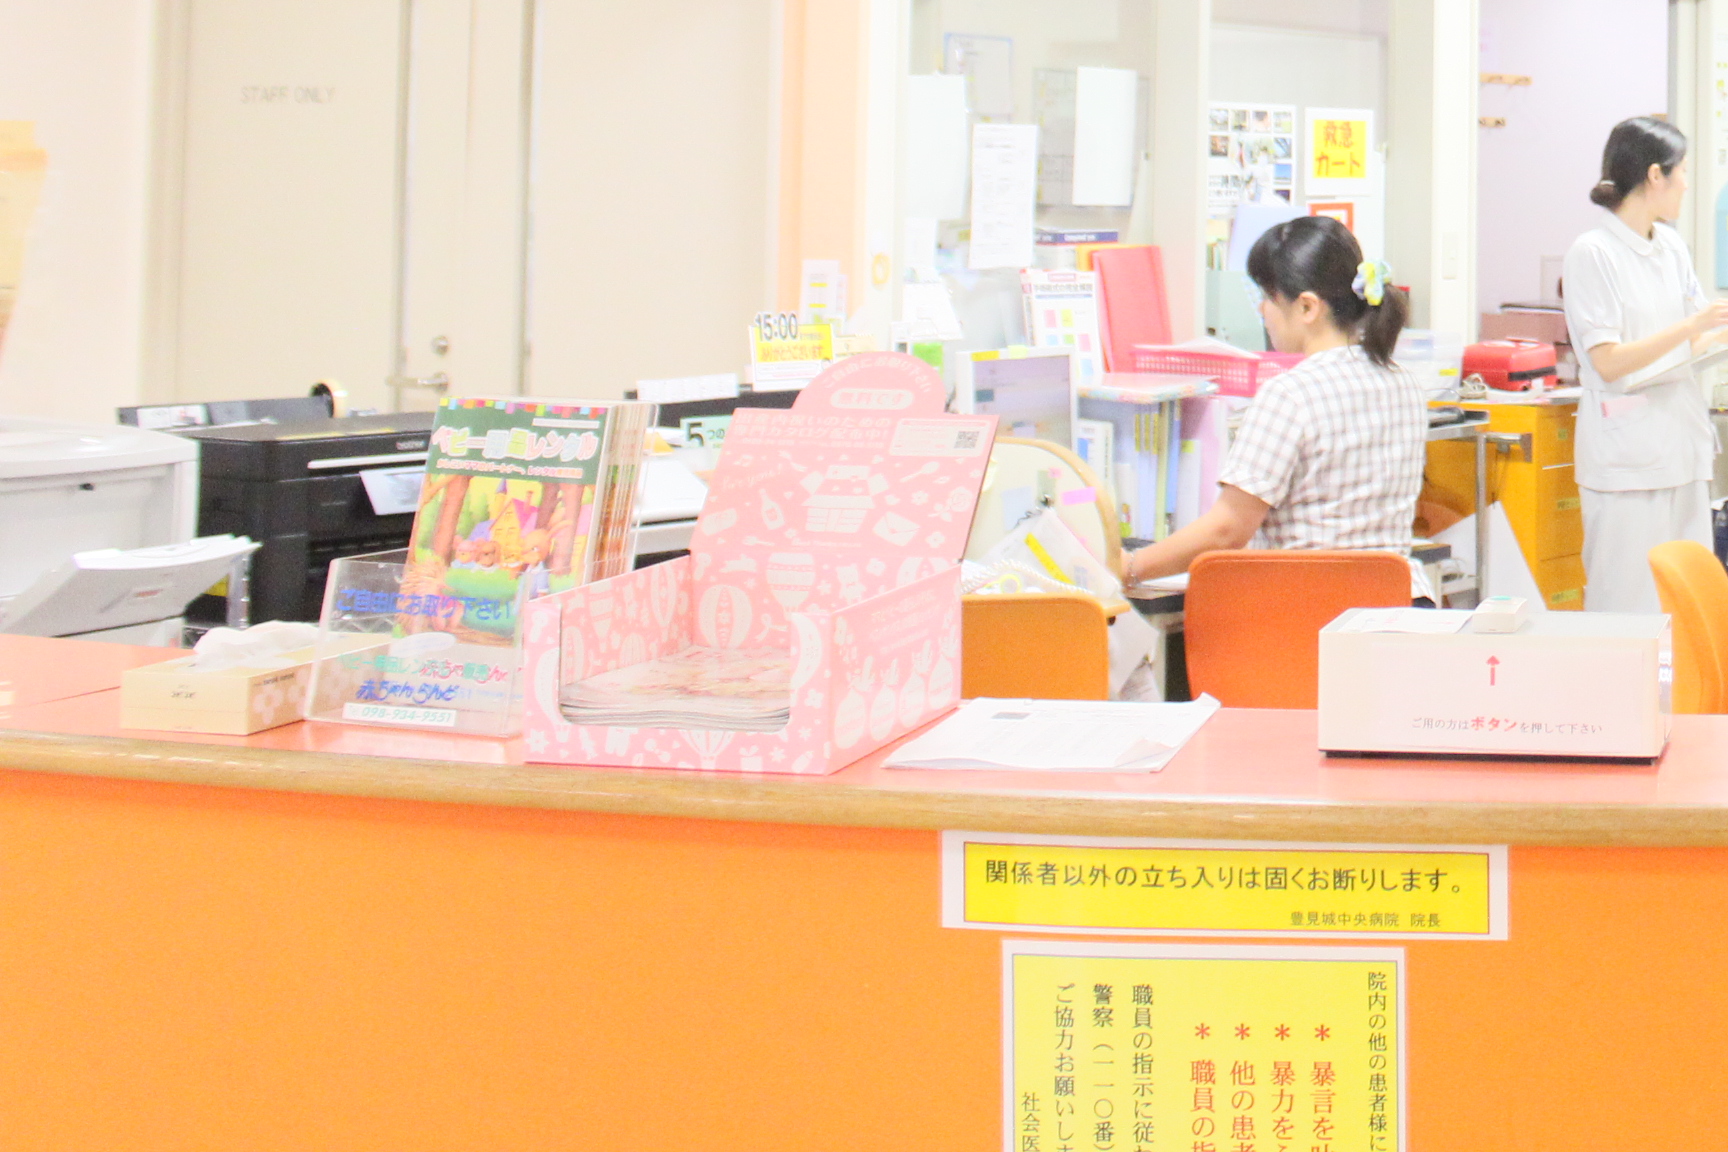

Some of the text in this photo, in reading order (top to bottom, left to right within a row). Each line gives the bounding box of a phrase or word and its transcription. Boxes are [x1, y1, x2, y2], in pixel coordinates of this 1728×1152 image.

[241, 85, 335, 104] STAFF ONLY
[1323, 121, 1354, 148] 救急
[1315, 151, 1361, 176] カート
[755, 313, 798, 342] 15:00
[837, 391, 907, 407] 無料です
[734, 413, 893, 429] 出産内祝いのための
[432, 425, 599, 462] ベビー用品レンタル
[335, 588, 511, 621] ご自由にお取り下さい
[361, 706, 453, 724] 098-934-9551
[1411, 716, 1603, 735] ご用の方はボタンを押して下さい
[985, 859, 1461, 894] 関係者以外の立ち入りは固くお断りします。
[1290, 910, 1441, 929] 豊見城中央病院 院長
[1367, 971, 1388, 1152] 院内の他の患者様に
[1270, 1061, 1296, 1152] 暴力を
[1021, 1092, 1041, 1152] 社会医
